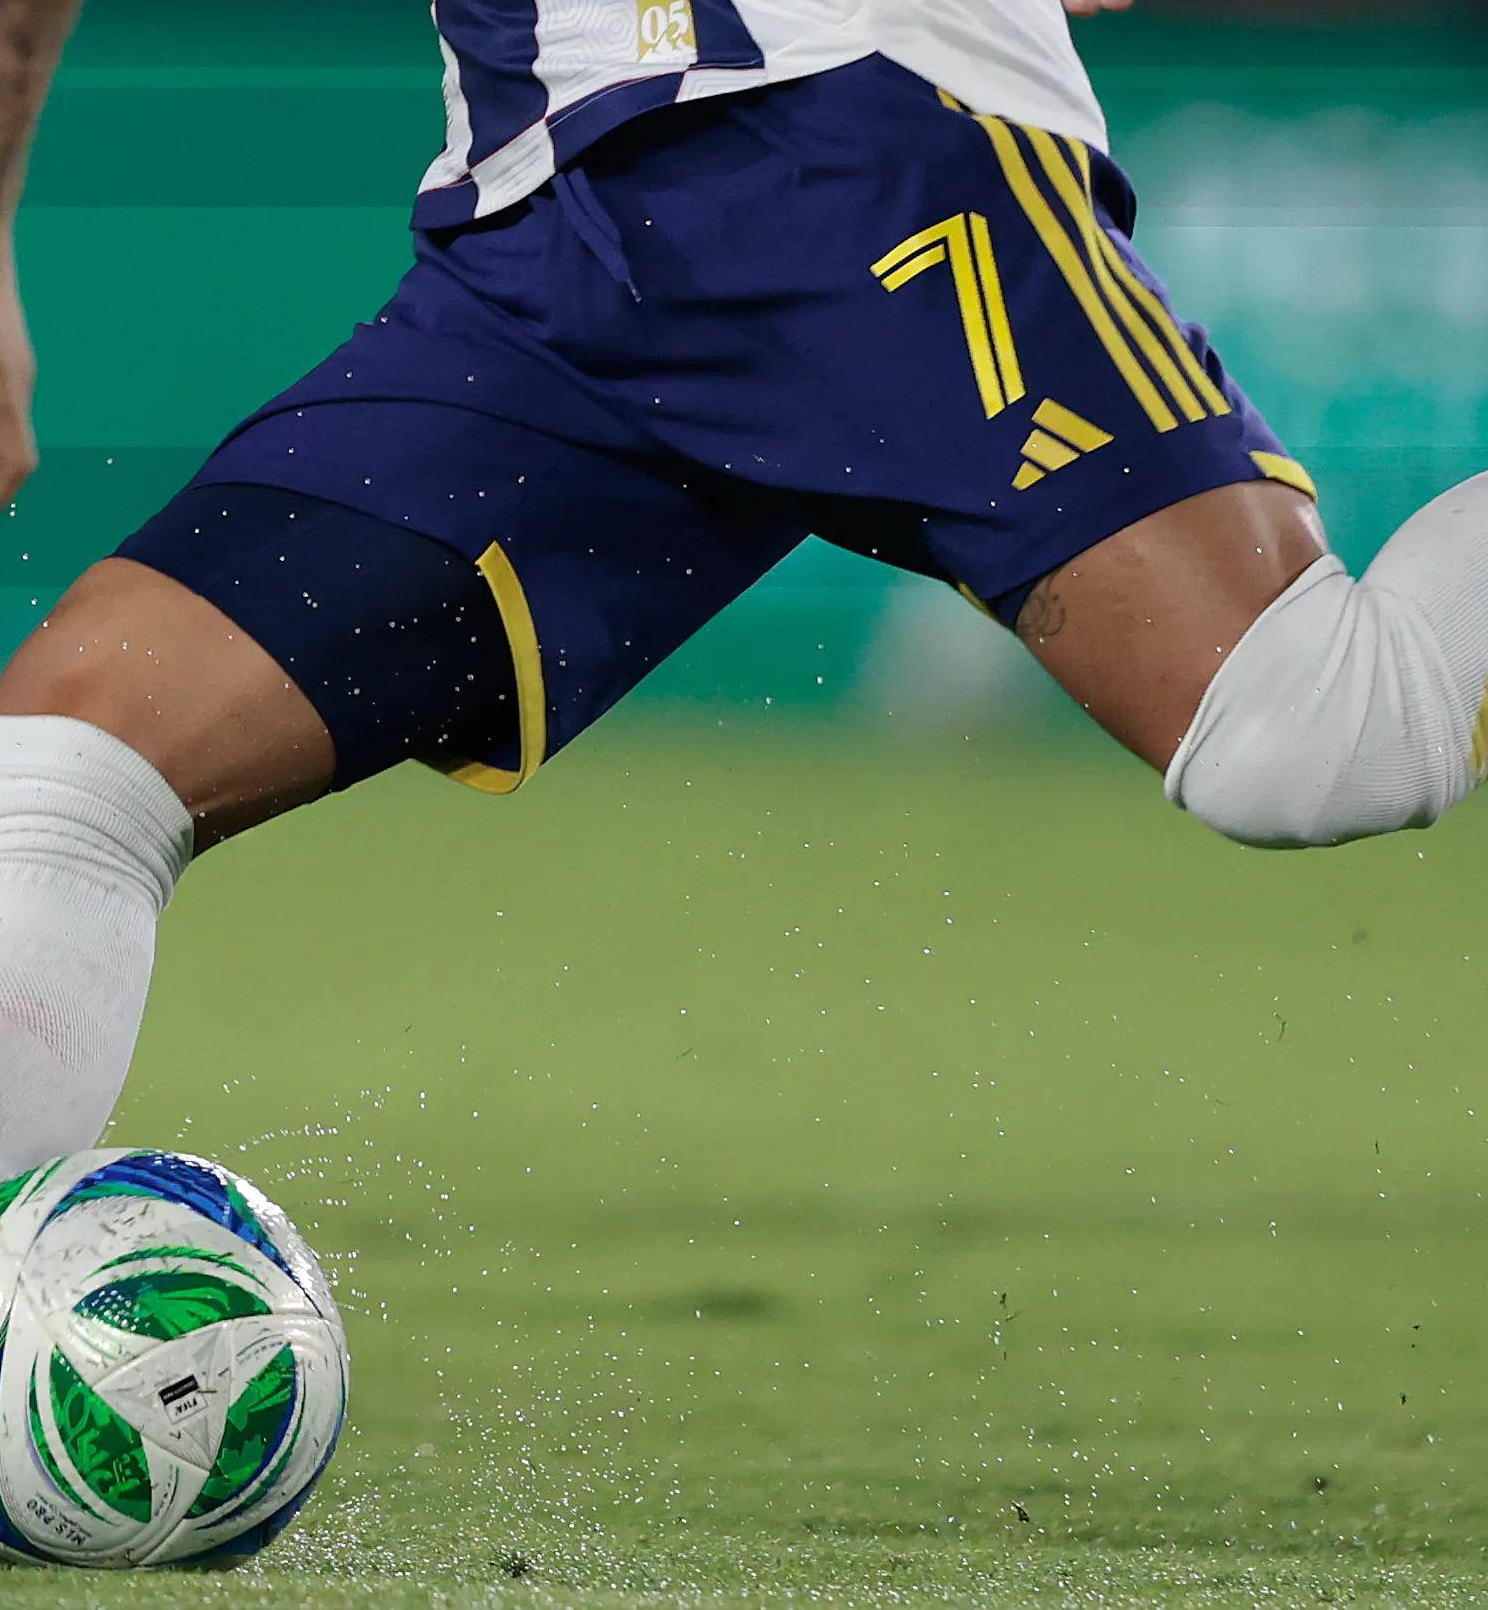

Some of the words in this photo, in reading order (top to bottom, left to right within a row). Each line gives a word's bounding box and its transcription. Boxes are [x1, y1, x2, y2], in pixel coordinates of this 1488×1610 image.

[870, 212, 1026, 420] 7
[174, 1397, 198, 1414] FIFA
[26, 1497, 56, 1526] PRO
[54, 1522, 88, 1547] MLS
